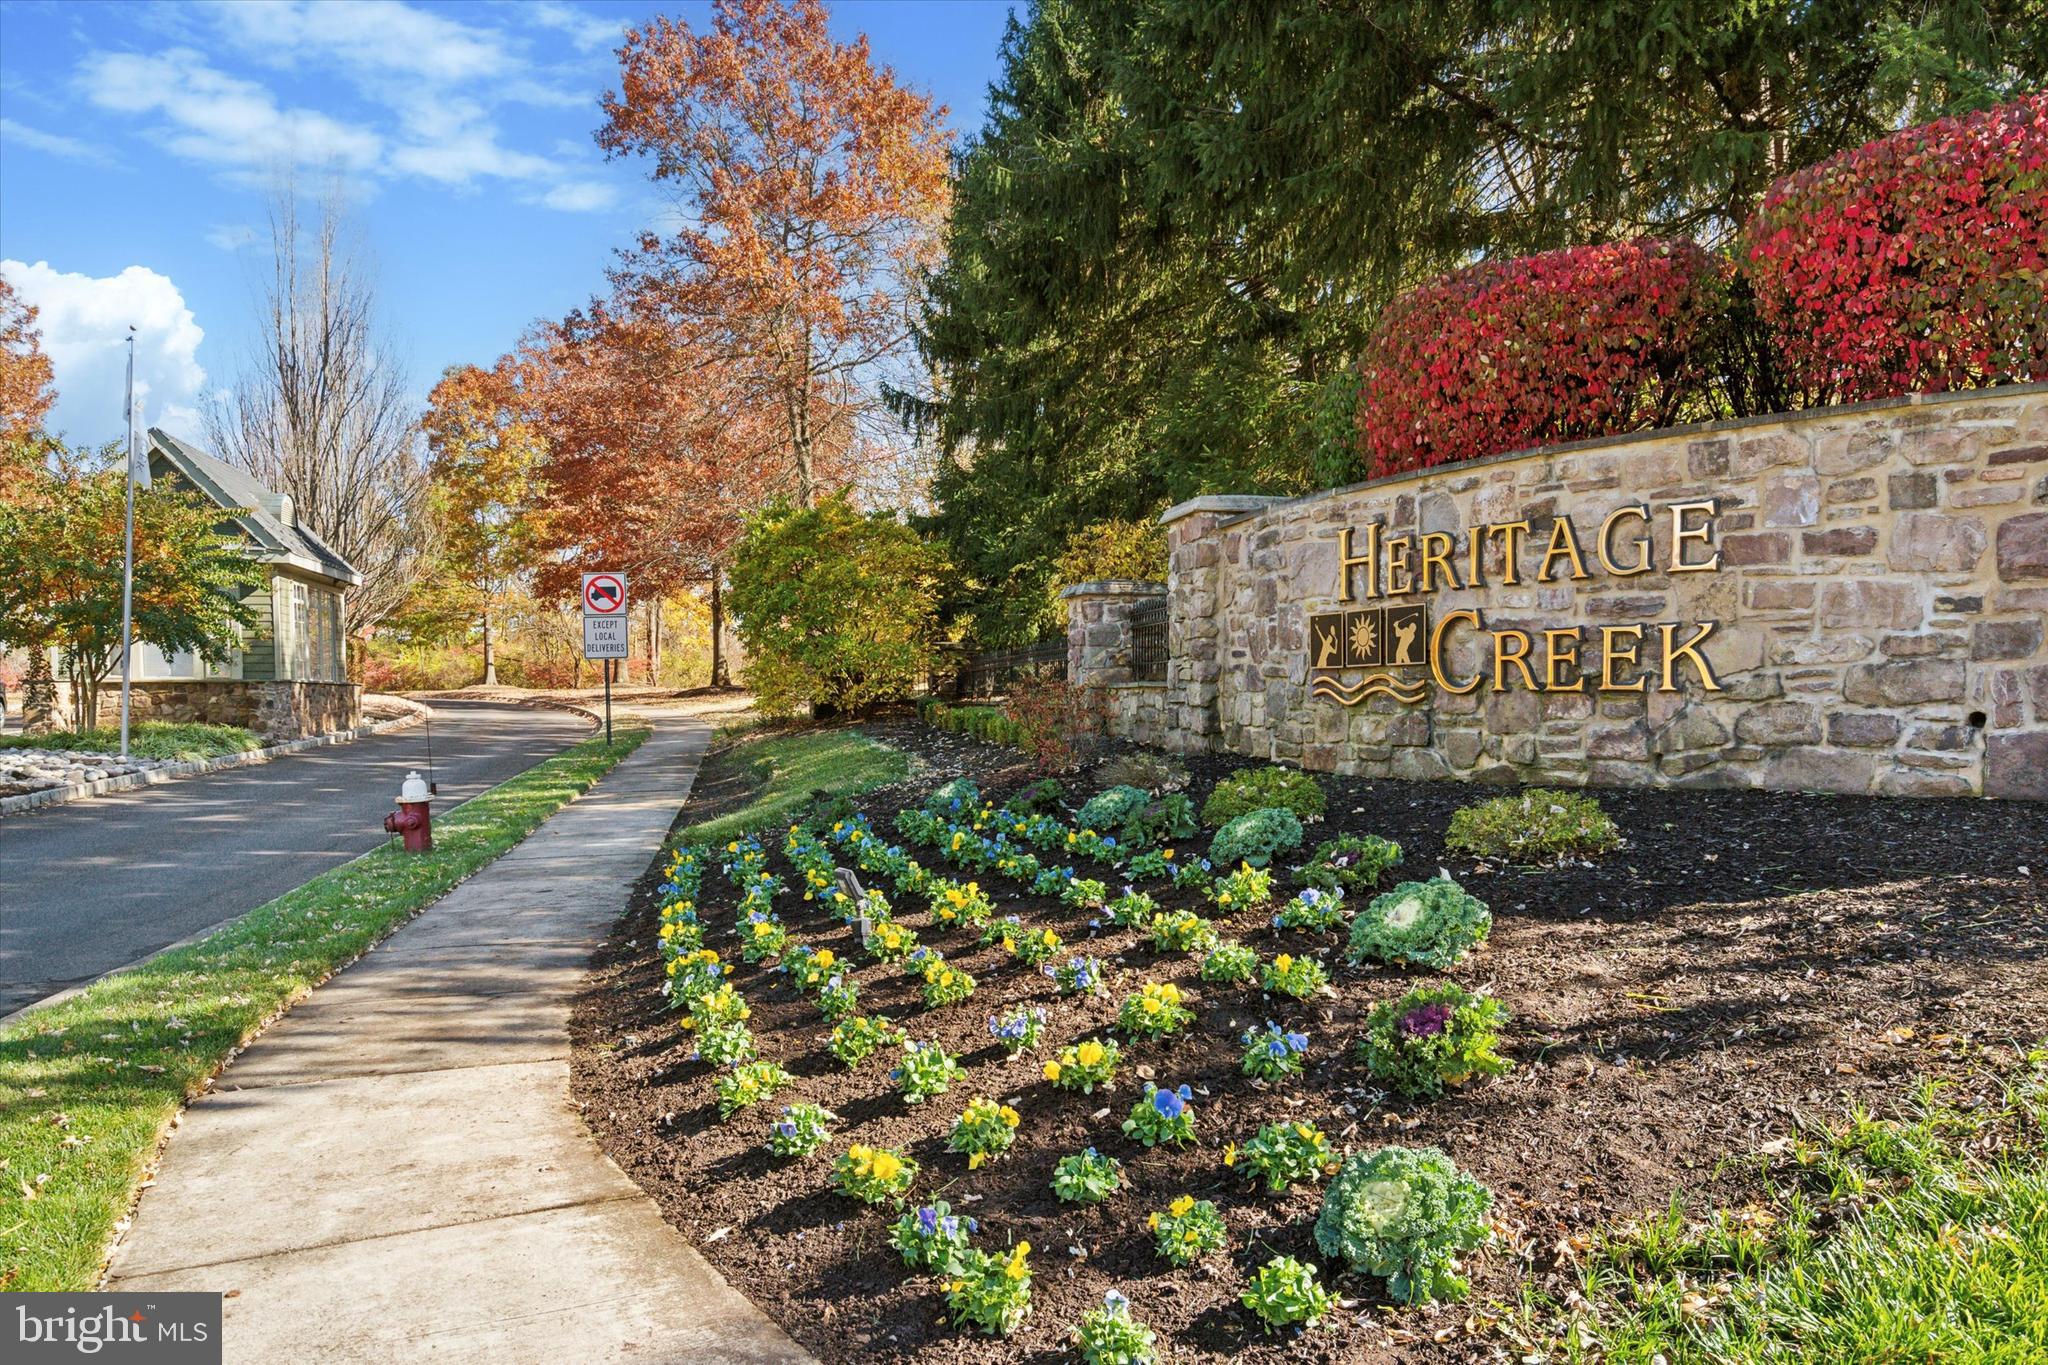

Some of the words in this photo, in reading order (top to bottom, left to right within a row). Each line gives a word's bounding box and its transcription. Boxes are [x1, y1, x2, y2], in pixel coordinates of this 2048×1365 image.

[1337, 500, 1720, 601] HERITAGE
[593, 620, 617, 629] EXCEPT
[594, 632, 616, 640] LOCAL
[587, 643, 625, 652] DELIVERIES
[1430, 608, 1721, 694] CREEK
